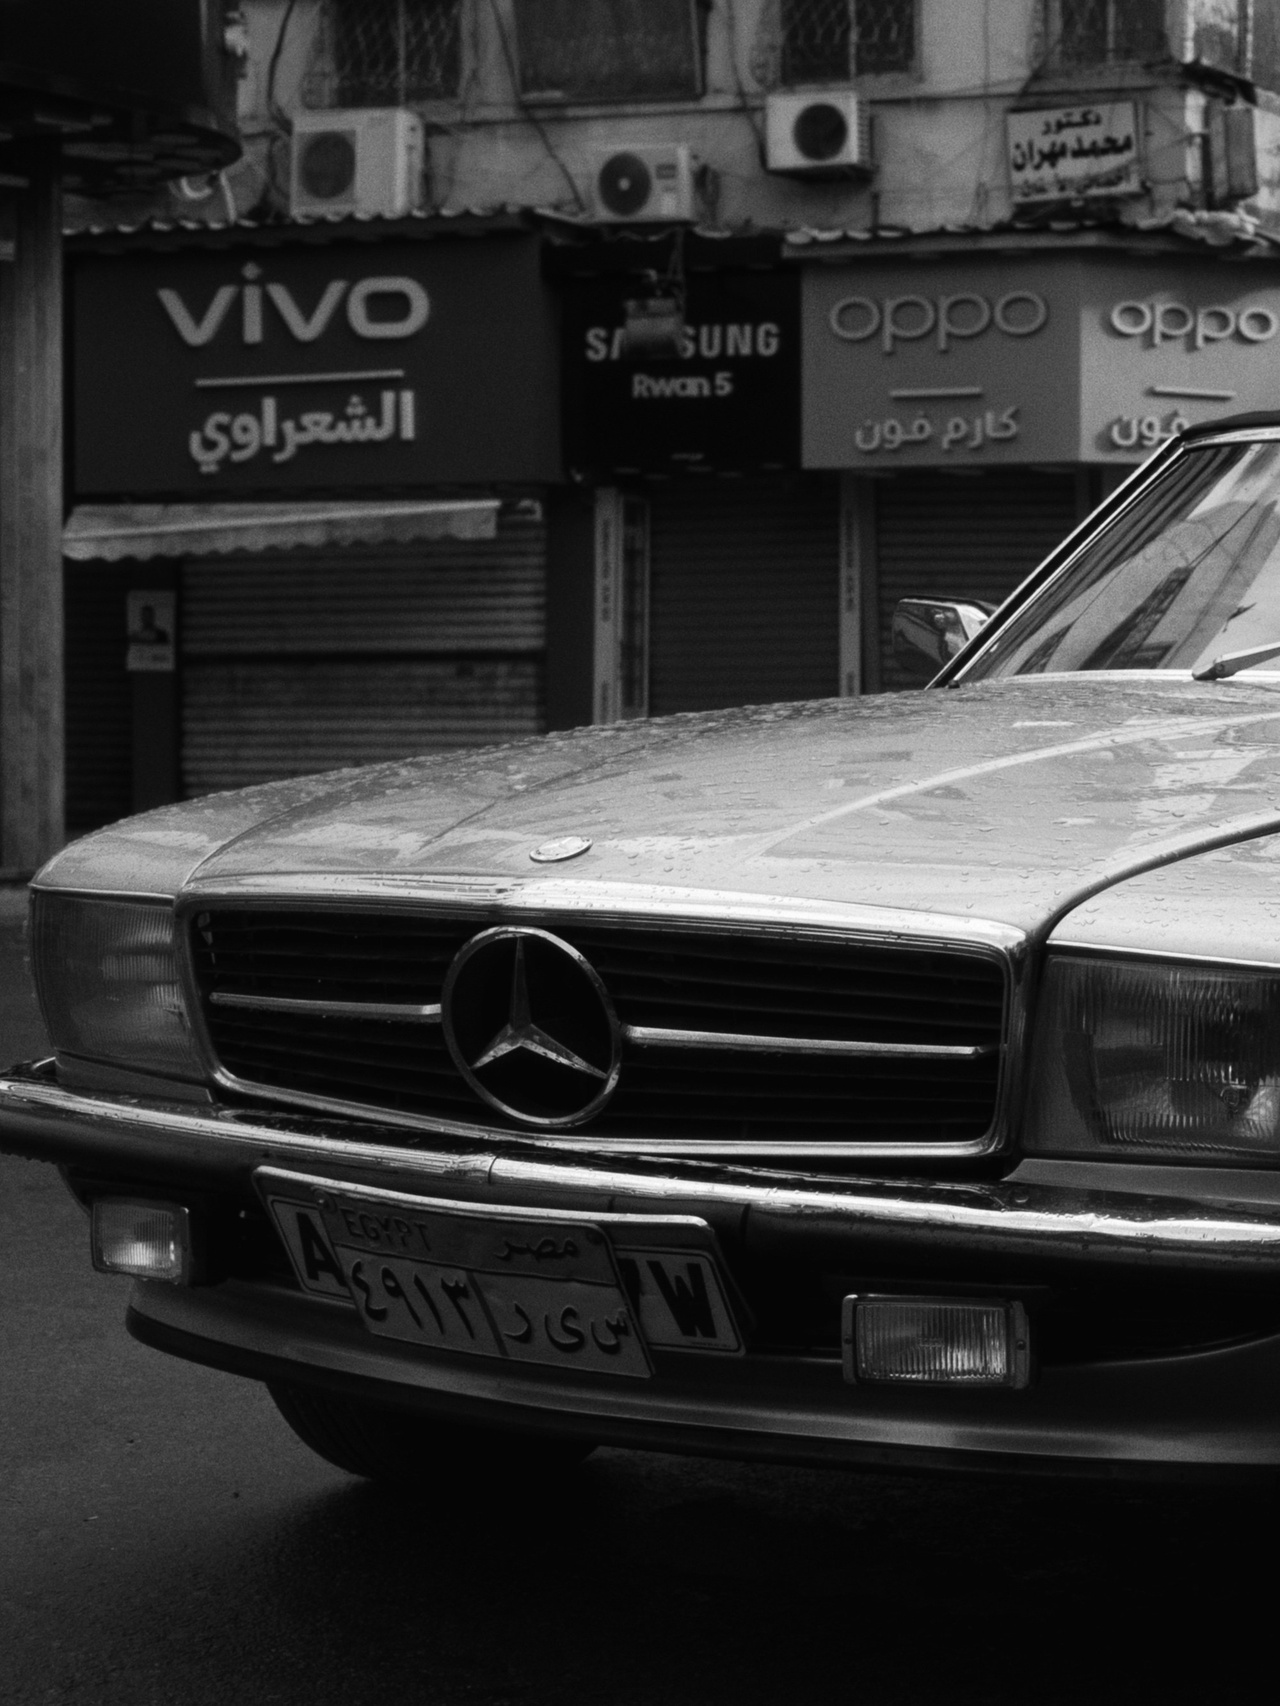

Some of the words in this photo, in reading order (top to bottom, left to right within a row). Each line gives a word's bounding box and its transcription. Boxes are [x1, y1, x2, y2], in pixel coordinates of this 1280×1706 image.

[1042, 109, 1102, 135] دكتور
[157, 260, 431, 347] vivo
[829, 289, 1047, 352] oppo
[1110, 300, 1278, 348] oppo
[632, 372, 711, 399] Rwan
[714, 371, 734, 396] 5
[188, 388, 416, 476] الشعراوي
[855, 410, 932, 450] فون
[941, 404, 1018, 450] كارم
[295, 1211, 347, 1288] A
[340, 1207, 432, 1251] EGYPT
[494, 1237, 579, 1262] مصر
